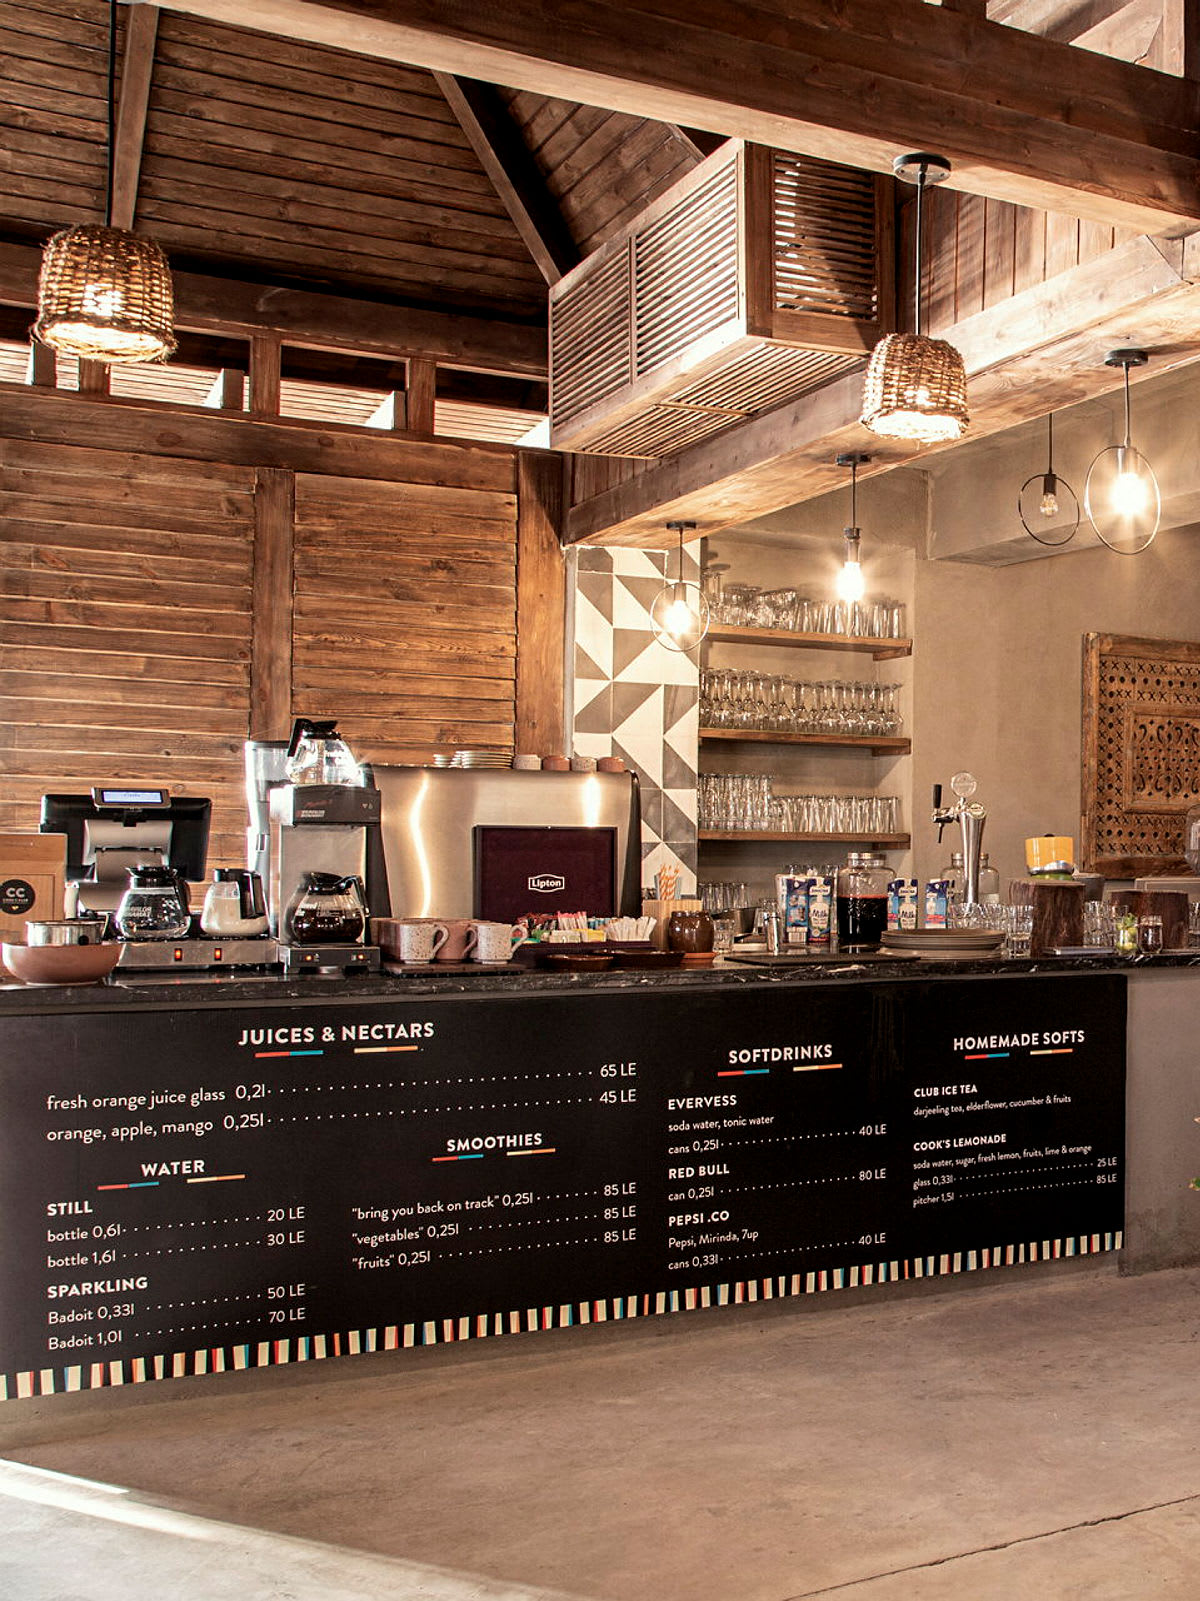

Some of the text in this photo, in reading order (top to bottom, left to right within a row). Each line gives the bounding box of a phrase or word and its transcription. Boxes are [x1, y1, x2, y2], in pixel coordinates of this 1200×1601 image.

[5, 887, 25, 898] CC
[532, 879, 562, 889] Lipton
[238, 1022, 434, 1046] JUICES & NECTARS
[954, 1030, 1085, 1051] HOMEMADE SOFTS
[729, 1044, 833, 1064] SOFTDRINKS
[47, 1095, 88, 1110] fresh
[92, 1094, 146, 1112] orange
[148, 1090, 186, 1110] juice
[190, 1088, 226, 1106] glass
[600, 1064, 617, 1078] 65
[620, 1062, 636, 1076] LE
[914, 1084, 978, 1098] CLUB ICE TEA
[668, 1095, 737, 1110] EVERVESS
[914, 1095, 1071, 1118] darjeeling tea, elderflower, cucumber & fruits
[47, 1128, 106, 1143] orange,
[112, 1122, 158, 1141] apple,
[162, 1121, 214, 1136] mango
[600, 1091, 617, 1104] 45
[620, 1089, 636, 1102] LE
[668, 1116, 774, 1132] soda water, tonic water
[447, 1133, 542, 1152] SMOOTHIES
[668, 1144, 689, 1154] cans
[859, 1126, 873, 1136] 40
[875, 1124, 887, 1135] LE
[914, 1134, 1007, 1151] COOK'S LEMONADE
[141, 1160, 204, 1177] WATER
[914, 1145, 1092, 1170] soda water, sugar, fresh lemon, fruits, lime & orange
[668, 1164, 730, 1180] RED BULL
[913, 1178, 931, 1191] glass
[1097, 1158, 1106, 1167] 25
[1108, 1157, 1117, 1166] LE
[668, 1192, 685, 1201] can
[859, 1170, 872, 1180] 80
[875, 1168, 886, 1179] LE
[913, 1195, 940, 1208] pitcher
[1096, 1175, 1106, 1184] 85
[1108, 1174, 1117, 1182] LE
[47, 1201, 93, 1217] STILL
[352, 1207, 389, 1222] "bring
[392, 1206, 414, 1220] you
[417, 1201, 444, 1214] back
[447, 1201, 462, 1212] on
[465, 1195, 500, 1210] track"
[604, 1184, 619, 1196] 85
[622, 1182, 636, 1194] LE
[48, 1228, 88, 1242] bottle
[267, 1209, 284, 1222] 20
[289, 1206, 305, 1220] LE
[352, 1226, 424, 1248] "vegetables"
[604, 1208, 619, 1220] 85
[622, 1206, 636, 1218] LE
[668, 1210, 729, 1227] PEPSI .CO
[48, 1255, 88, 1268] bottle
[267, 1234, 284, 1246] 30
[289, 1231, 305, 1244] LE
[352, 1255, 394, 1270] "fruits"
[604, 1231, 619, 1242] 85
[622, 1228, 636, 1240] LE
[668, 1229, 758, 1250] Pepsi, Mirinda, 7up
[668, 1260, 689, 1270] cans
[858, 1234, 872, 1245] 40
[875, 1233, 886, 1244] LE
[48, 1277, 148, 1298] SPARKLING
[49, 1309, 93, 1324] Badoit
[267, 1286, 284, 1298] 50
[289, 1284, 306, 1297] LE
[49, 1334, 93, 1350] Badoit
[269, 1311, 285, 1324] 70
[289, 1308, 306, 1321] LE
